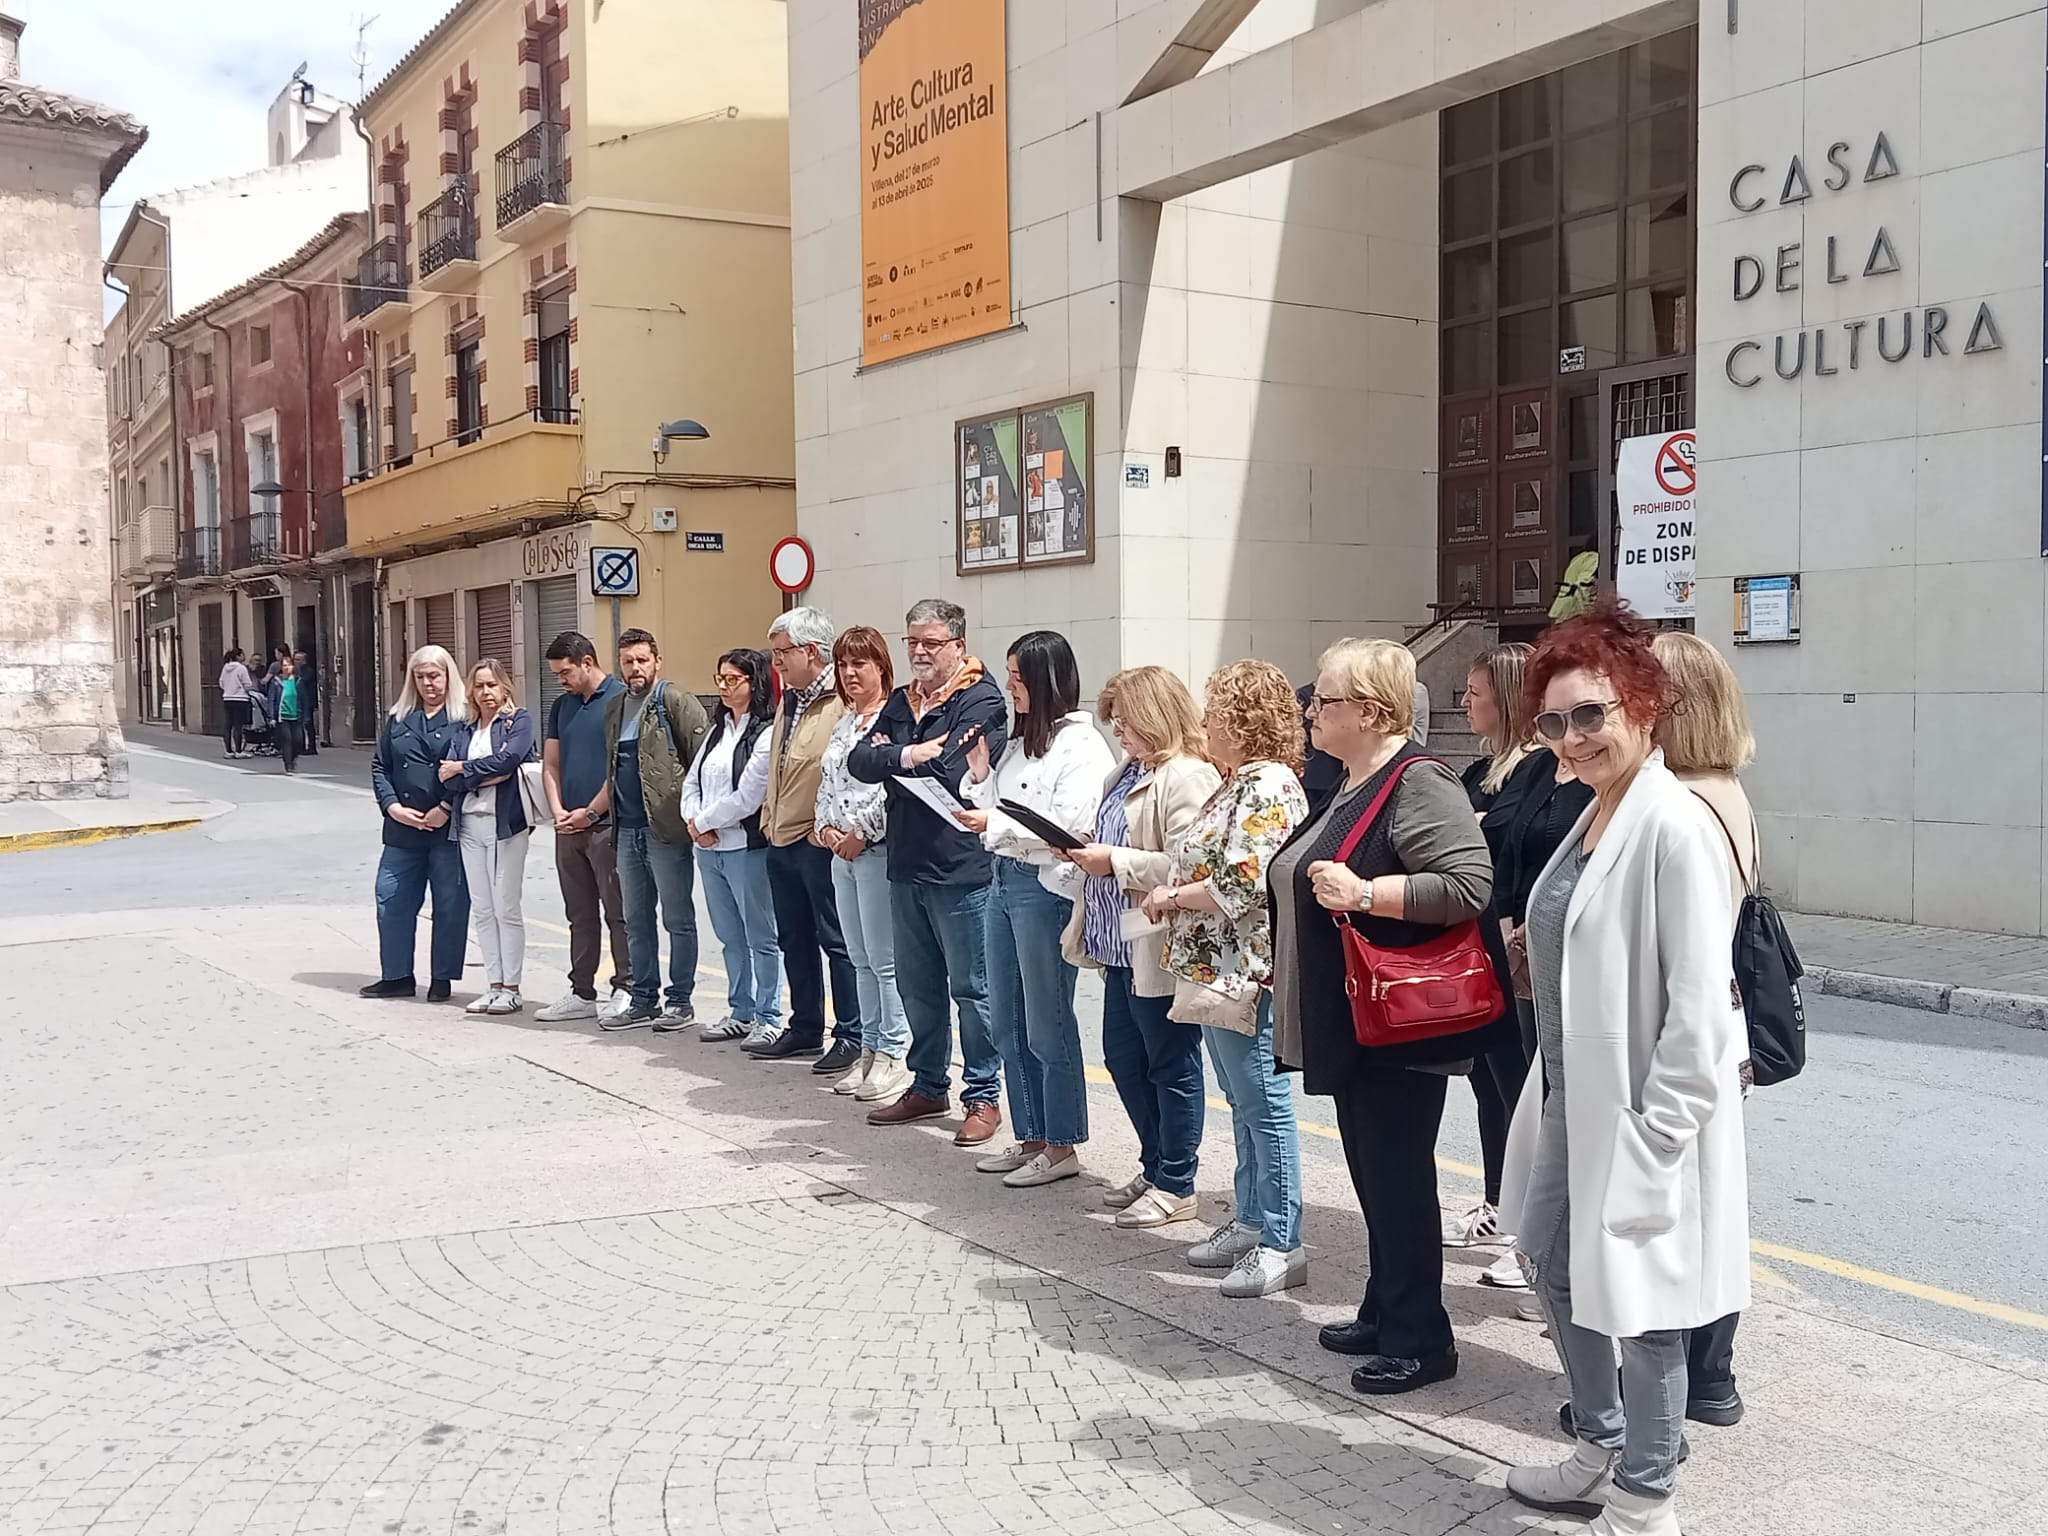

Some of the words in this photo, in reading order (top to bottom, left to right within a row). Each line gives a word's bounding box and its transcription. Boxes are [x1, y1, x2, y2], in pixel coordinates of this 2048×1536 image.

[871, 94, 908, 130] Arte,
[910, 62, 973, 110] Cultura
[871, 142, 881, 172] y
[884, 113, 928, 160] Salud
[931, 84, 994, 138] Mental
[894, 169, 905, 184] del
[912, 163, 921, 176] de
[1729, 130, 1899, 213] CASA
[885, 192, 894, 204] de
[1733, 242, 1801, 302] DE
[1827, 226, 1900, 285] LA
[1725, 301, 2003, 388] CULTURA
[1633, 499, 1691, 516] PROHIBIDO
[693, 535, 716, 543] CALLE
[1656, 521, 1696, 540] ZON
[1625, 548, 1647, 566] DE
